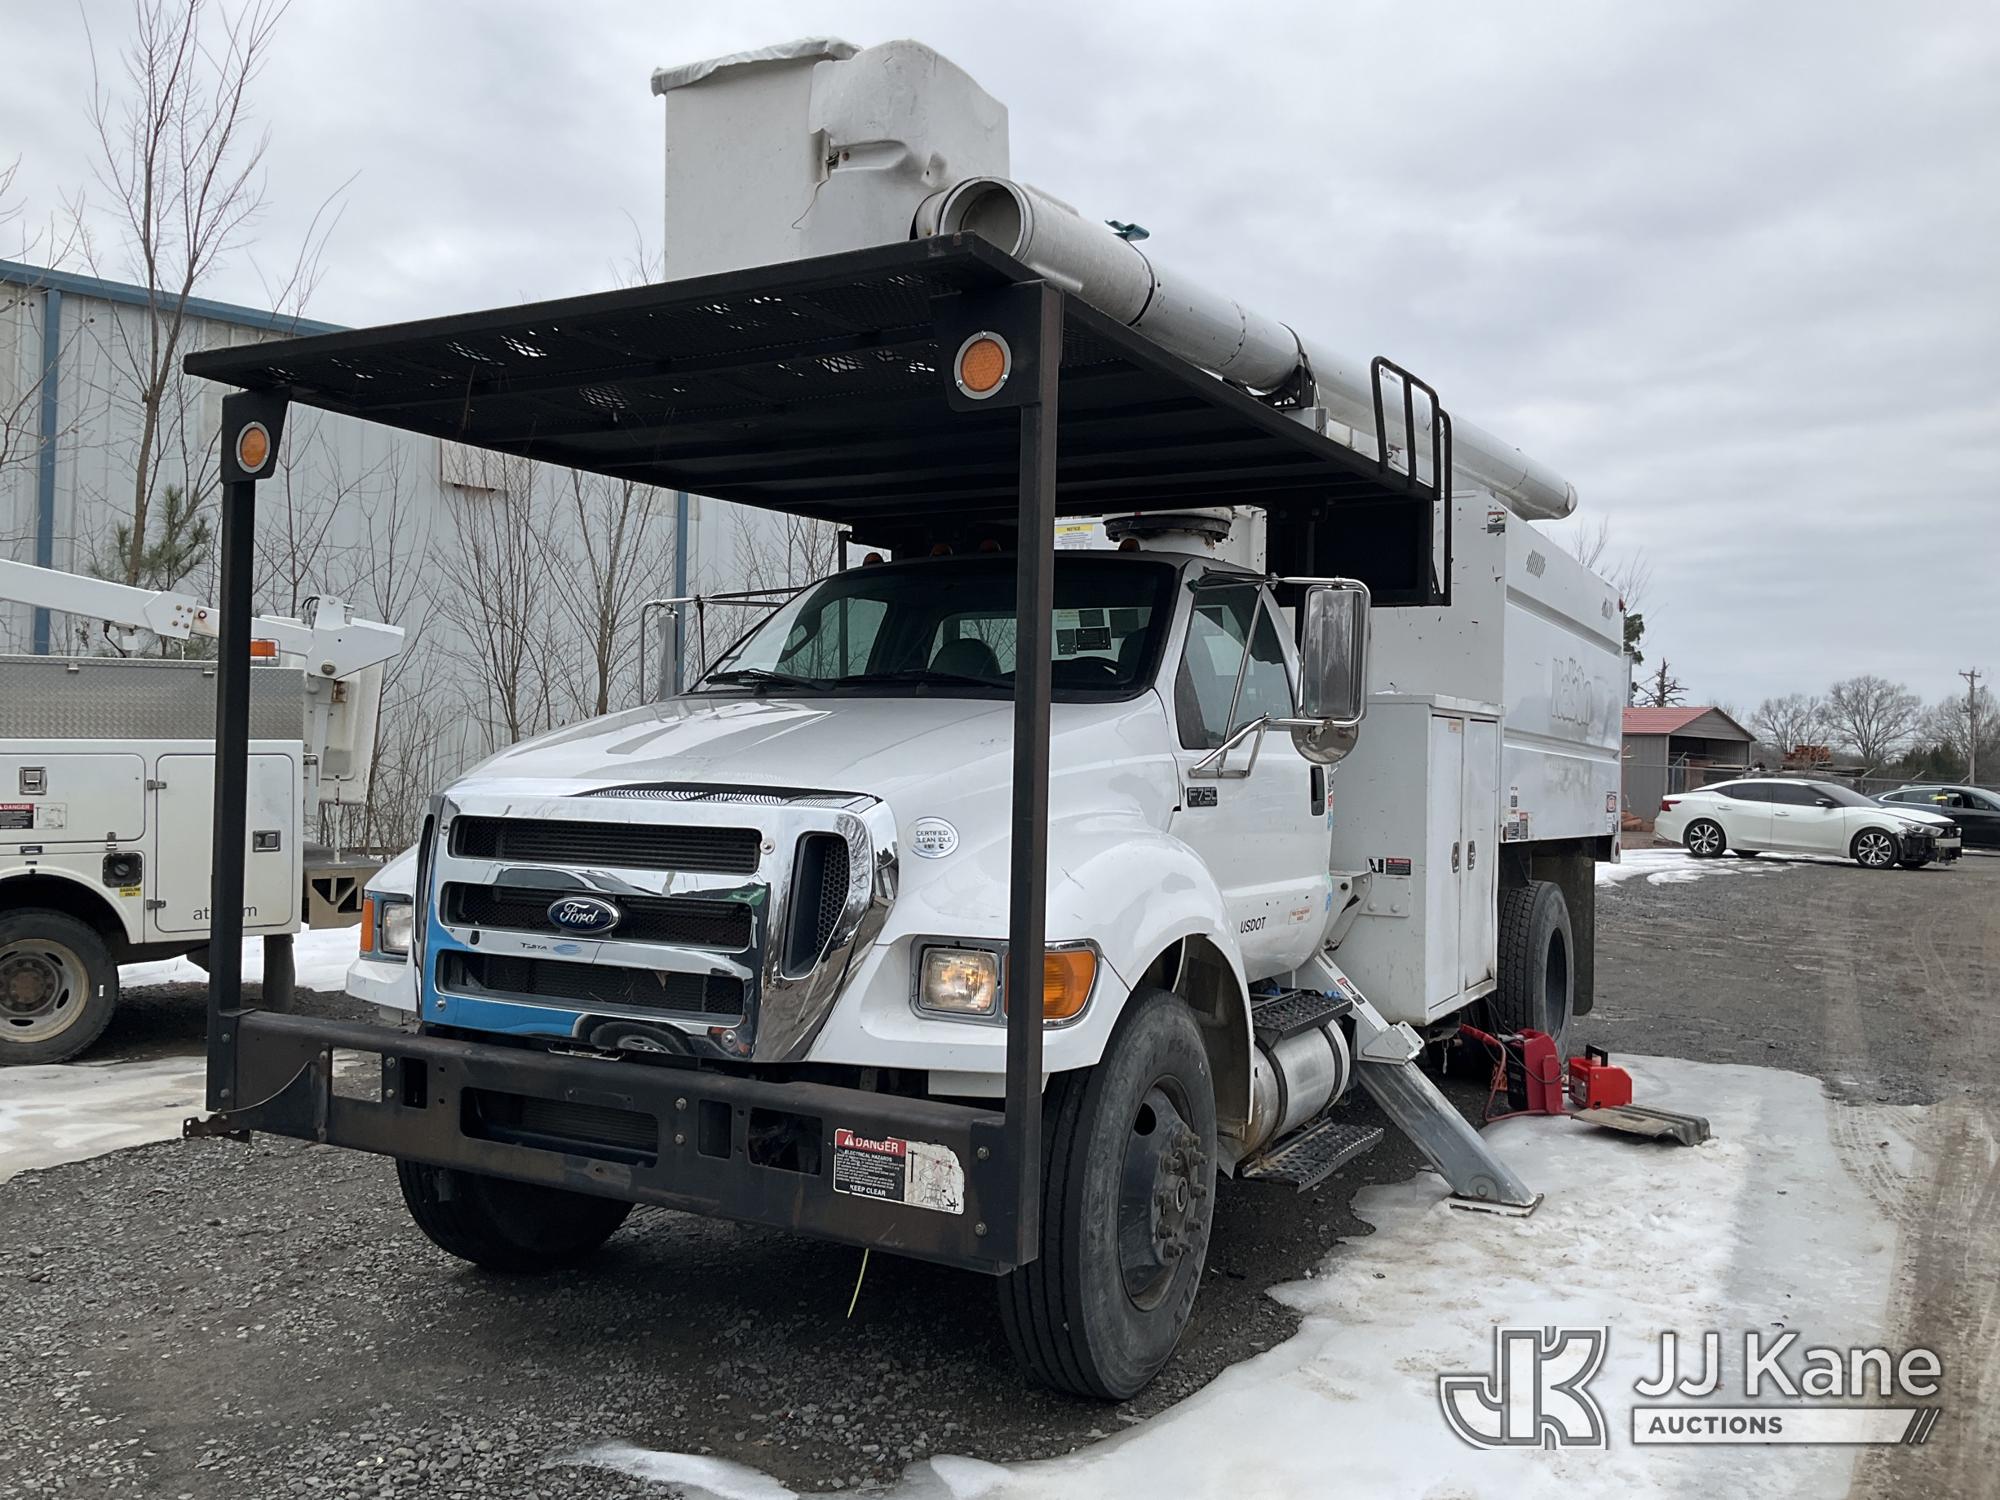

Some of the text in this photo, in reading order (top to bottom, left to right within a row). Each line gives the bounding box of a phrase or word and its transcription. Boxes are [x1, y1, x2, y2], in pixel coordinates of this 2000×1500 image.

[560, 902, 599, 924] Ford
[1240, 917, 1266, 933] USDOT
[855, 1138, 898, 1153] DANGER
[844, 1149, 892, 1162] ELECTRICAL HAZARDS
[850, 1184, 886, 1196] KEEP CLEAR
